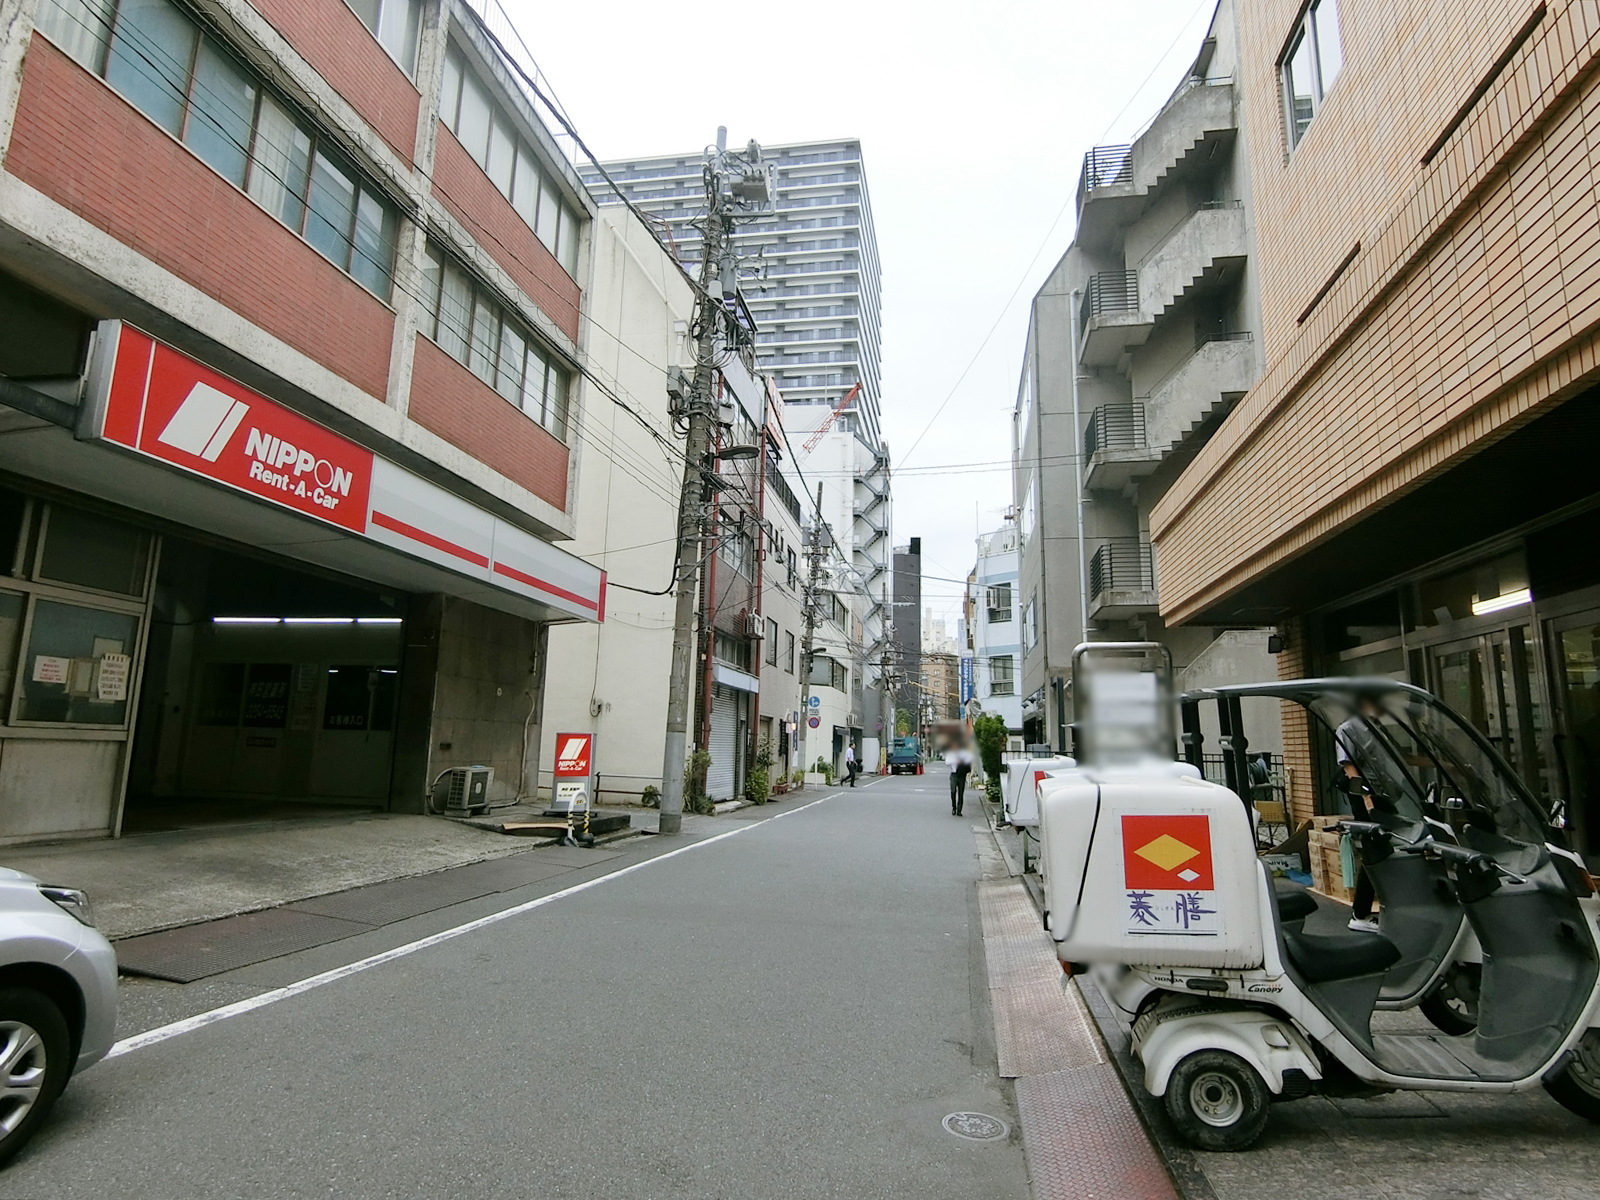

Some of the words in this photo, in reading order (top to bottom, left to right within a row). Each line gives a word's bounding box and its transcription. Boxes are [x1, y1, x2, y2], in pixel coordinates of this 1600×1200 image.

[244, 426, 353, 497] NIPPON
[249, 460, 339, 510] Rent-A-Car
[1154, 976, 1184, 984] HONDA
[1247, 983, 1284, 994] Canopy
